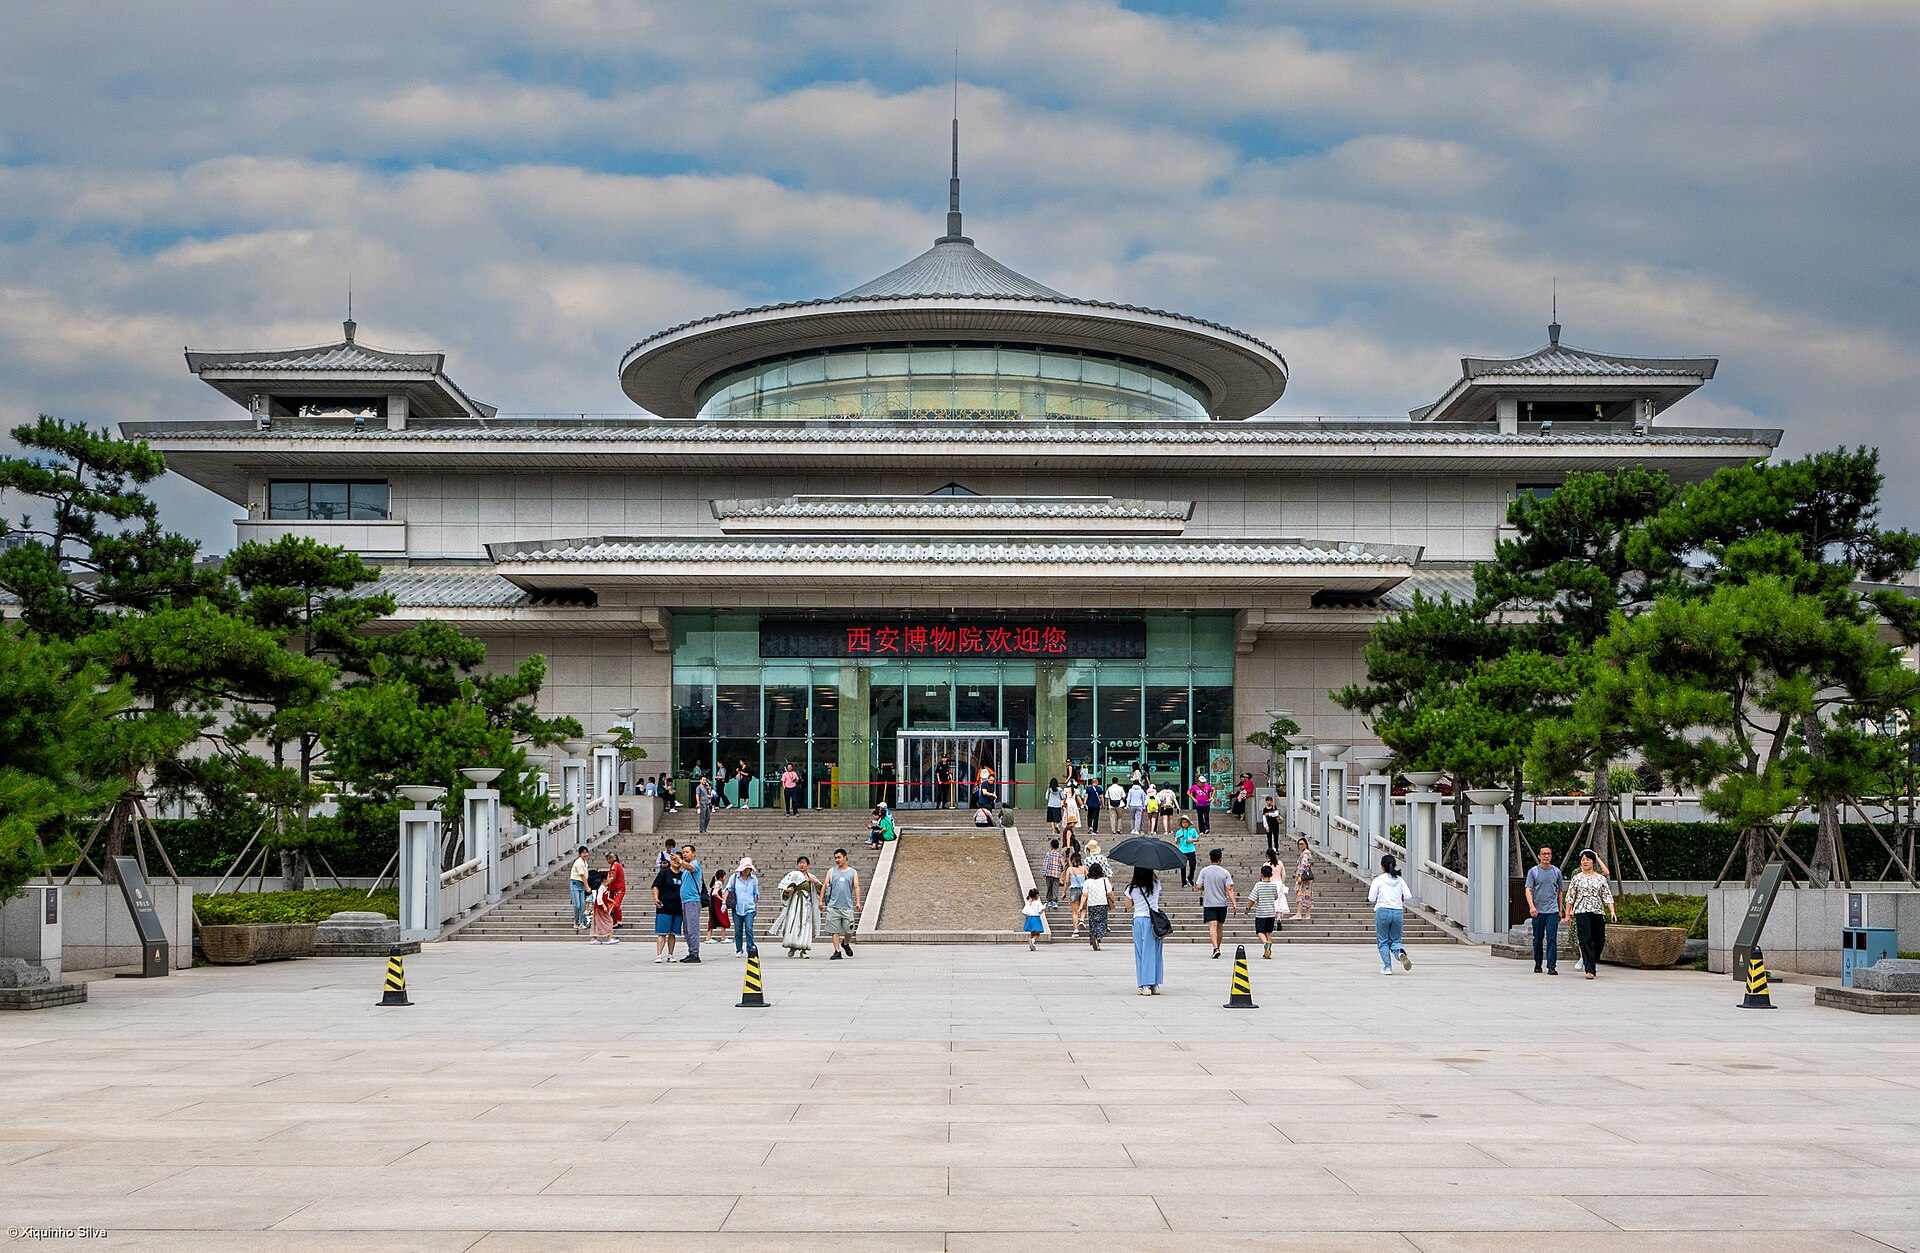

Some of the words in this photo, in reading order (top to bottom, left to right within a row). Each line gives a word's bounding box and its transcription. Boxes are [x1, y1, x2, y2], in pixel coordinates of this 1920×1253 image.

[846, 626, 1067, 653] 西安博物院欢迎您
